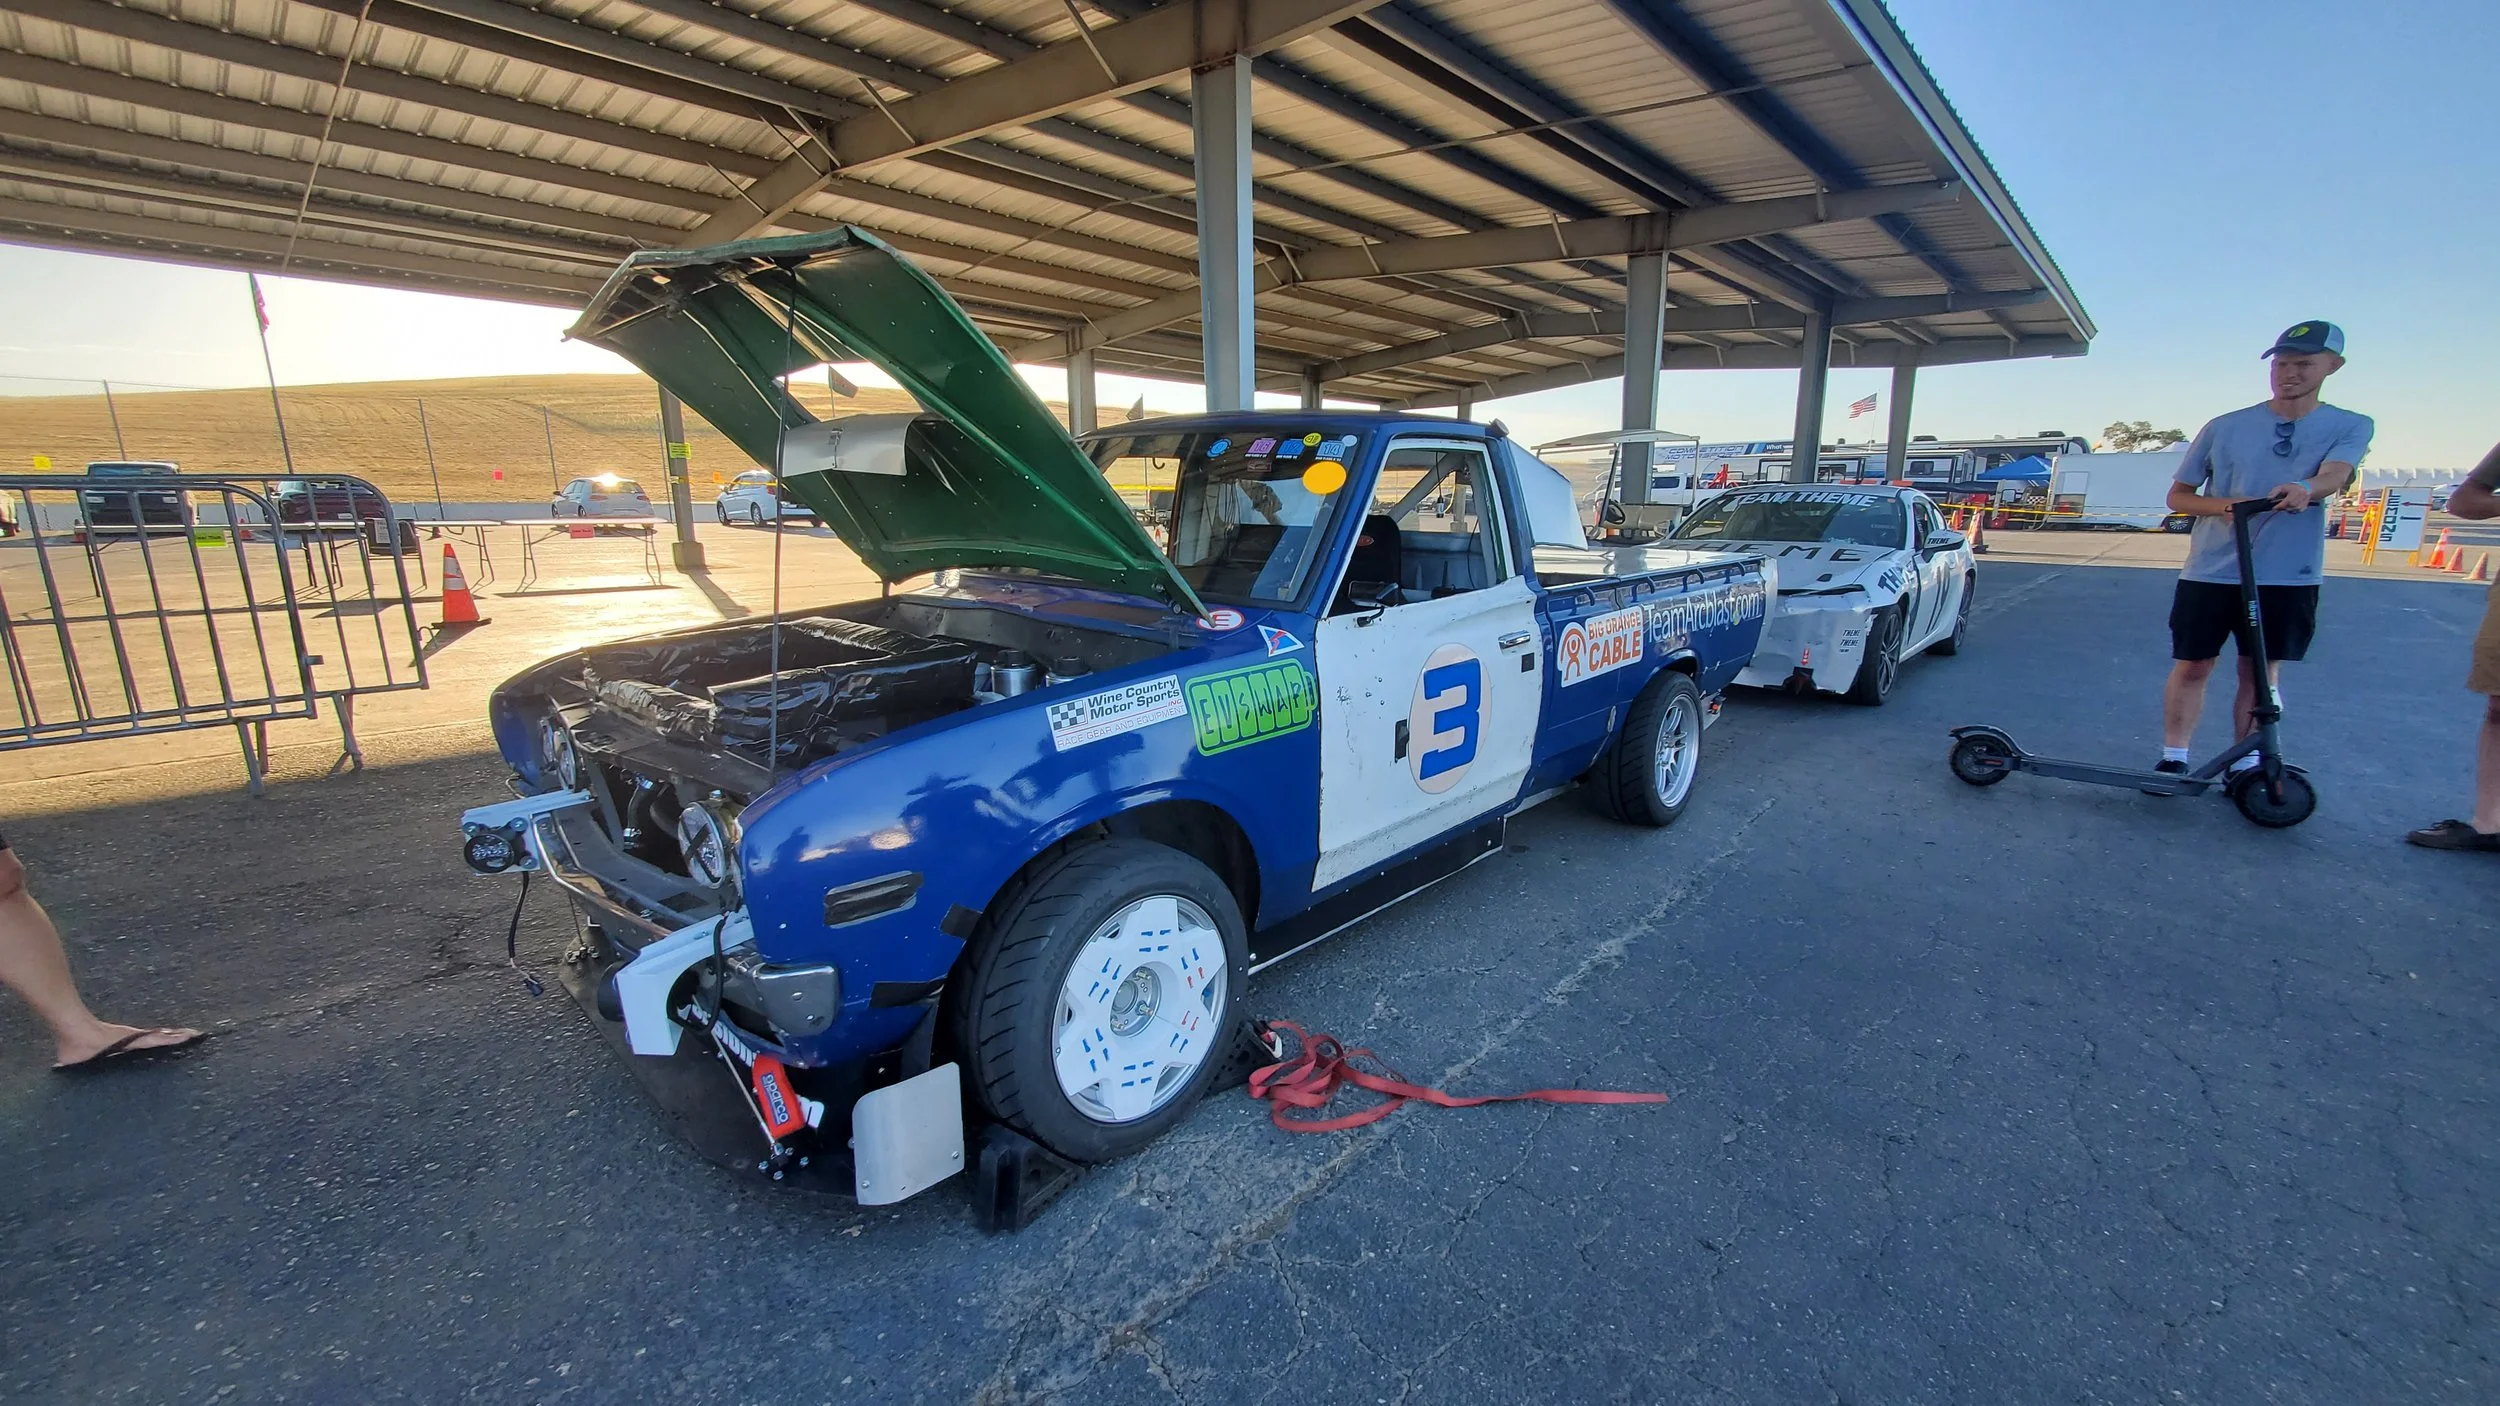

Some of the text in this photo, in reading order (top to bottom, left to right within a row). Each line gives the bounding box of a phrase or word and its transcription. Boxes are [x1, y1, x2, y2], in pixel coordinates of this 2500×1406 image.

[1324, 443, 1340, 455] 14
[1734, 491, 1878, 507] TEAM THEME
[2379, 490, 2401, 542] LEMONS
[1588, 612, 1640, 640] BIG ORANGE
[1641, 590, 1761, 643] TeamArcblast.com
[1589, 631, 1641, 671] CABLE
[1088, 679, 1176, 708] Wine Country
[1090, 689, 1180, 720] Motor Sports
[1058, 706, 1185, 747] RACE GEAR AND EQUIPMENT
[1420, 658, 1482, 781] 3
[765, 1074, 789, 1124] sparco
